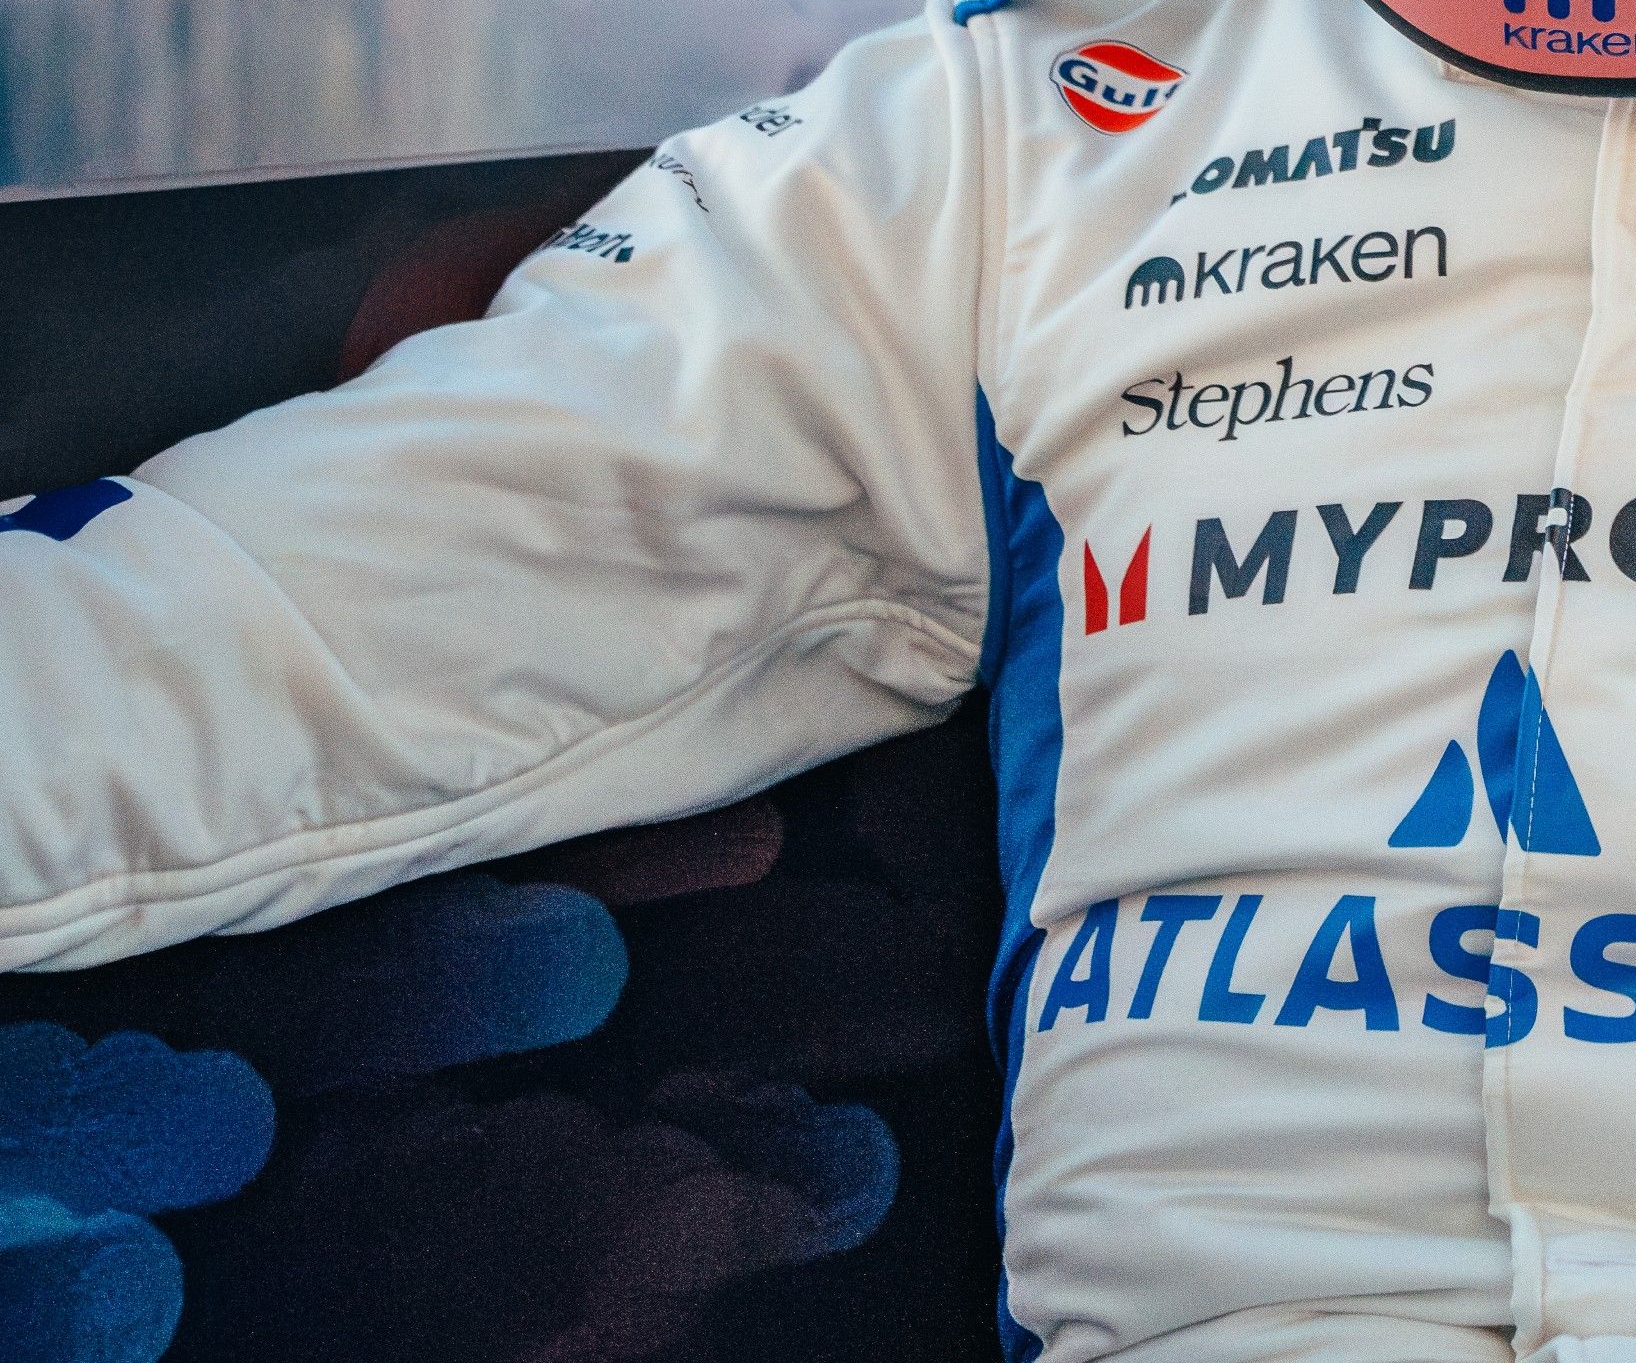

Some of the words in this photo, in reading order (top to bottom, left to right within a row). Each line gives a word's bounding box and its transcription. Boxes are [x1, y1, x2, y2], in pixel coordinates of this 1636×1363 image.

[1169, 117, 1457, 207] OMATSU
[1192, 225, 1448, 300] kraken
[1120, 355, 1435, 442] Stephens
